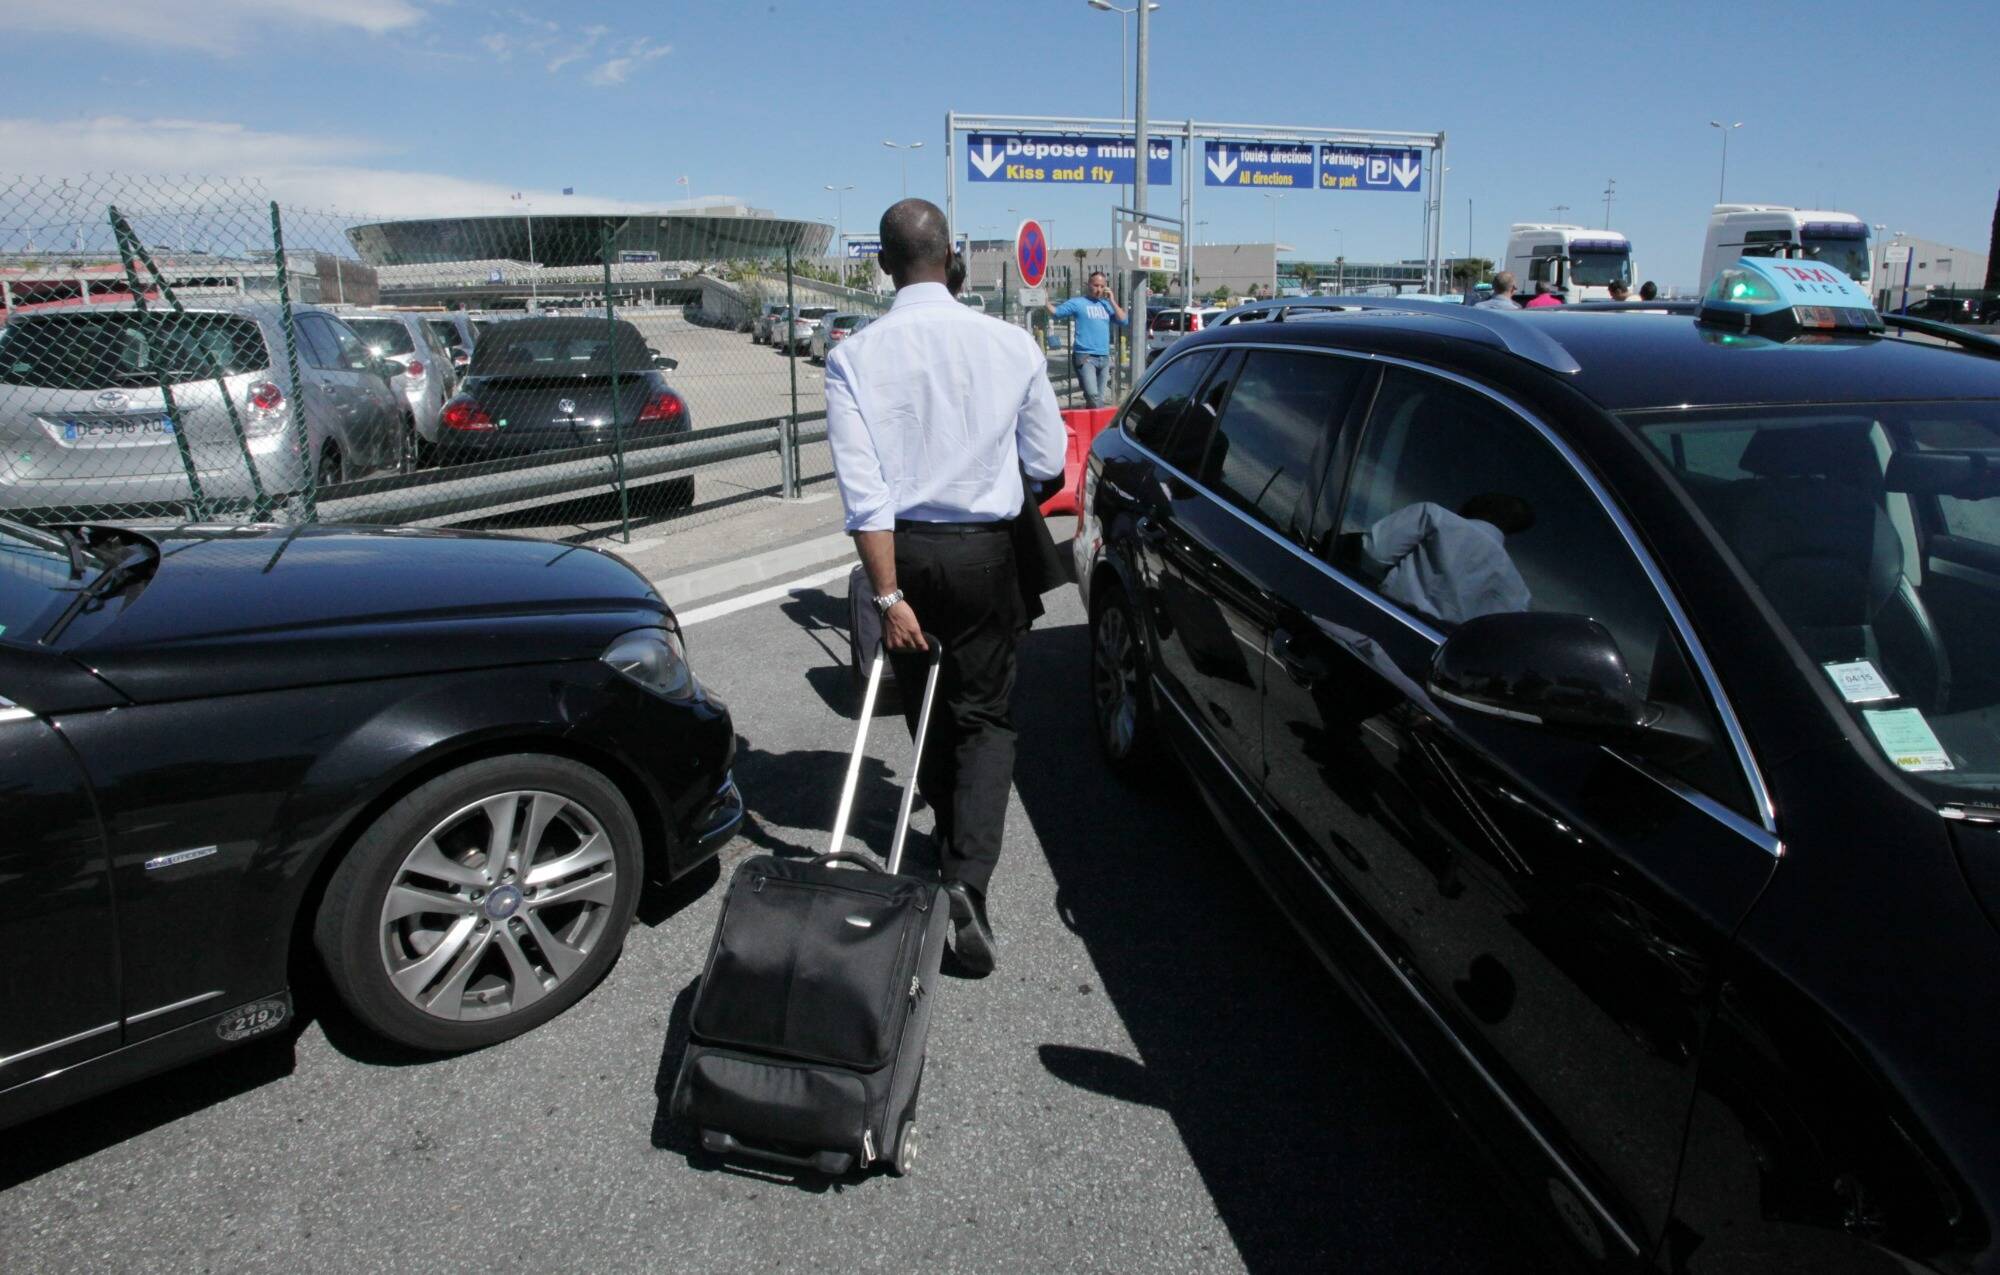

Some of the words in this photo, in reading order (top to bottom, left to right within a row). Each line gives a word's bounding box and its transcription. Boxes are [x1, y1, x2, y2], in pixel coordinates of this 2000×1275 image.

[1006, 138, 1089, 160] Dépose
[1097, 141, 1170, 160] minte
[1240, 145, 1269, 163] Toutes
[1271, 147, 1313, 165] directions
[1322, 149, 1365, 169] Parkings
[1006, 165, 1045, 180] Kiss
[1052, 166, 1084, 181] and
[1091, 166, 1114, 184] fly
[1239, 171, 1251, 185] All
[1253, 171, 1293, 186] directions
[1371, 160, 1387, 180] P
[1322, 173, 1337, 186] Car
[1339, 174, 1358, 189] park
[1774, 266, 1839, 283] TAXI
[1794, 283, 1849, 295] NICE
[234, 1009, 270, 1032] 219
